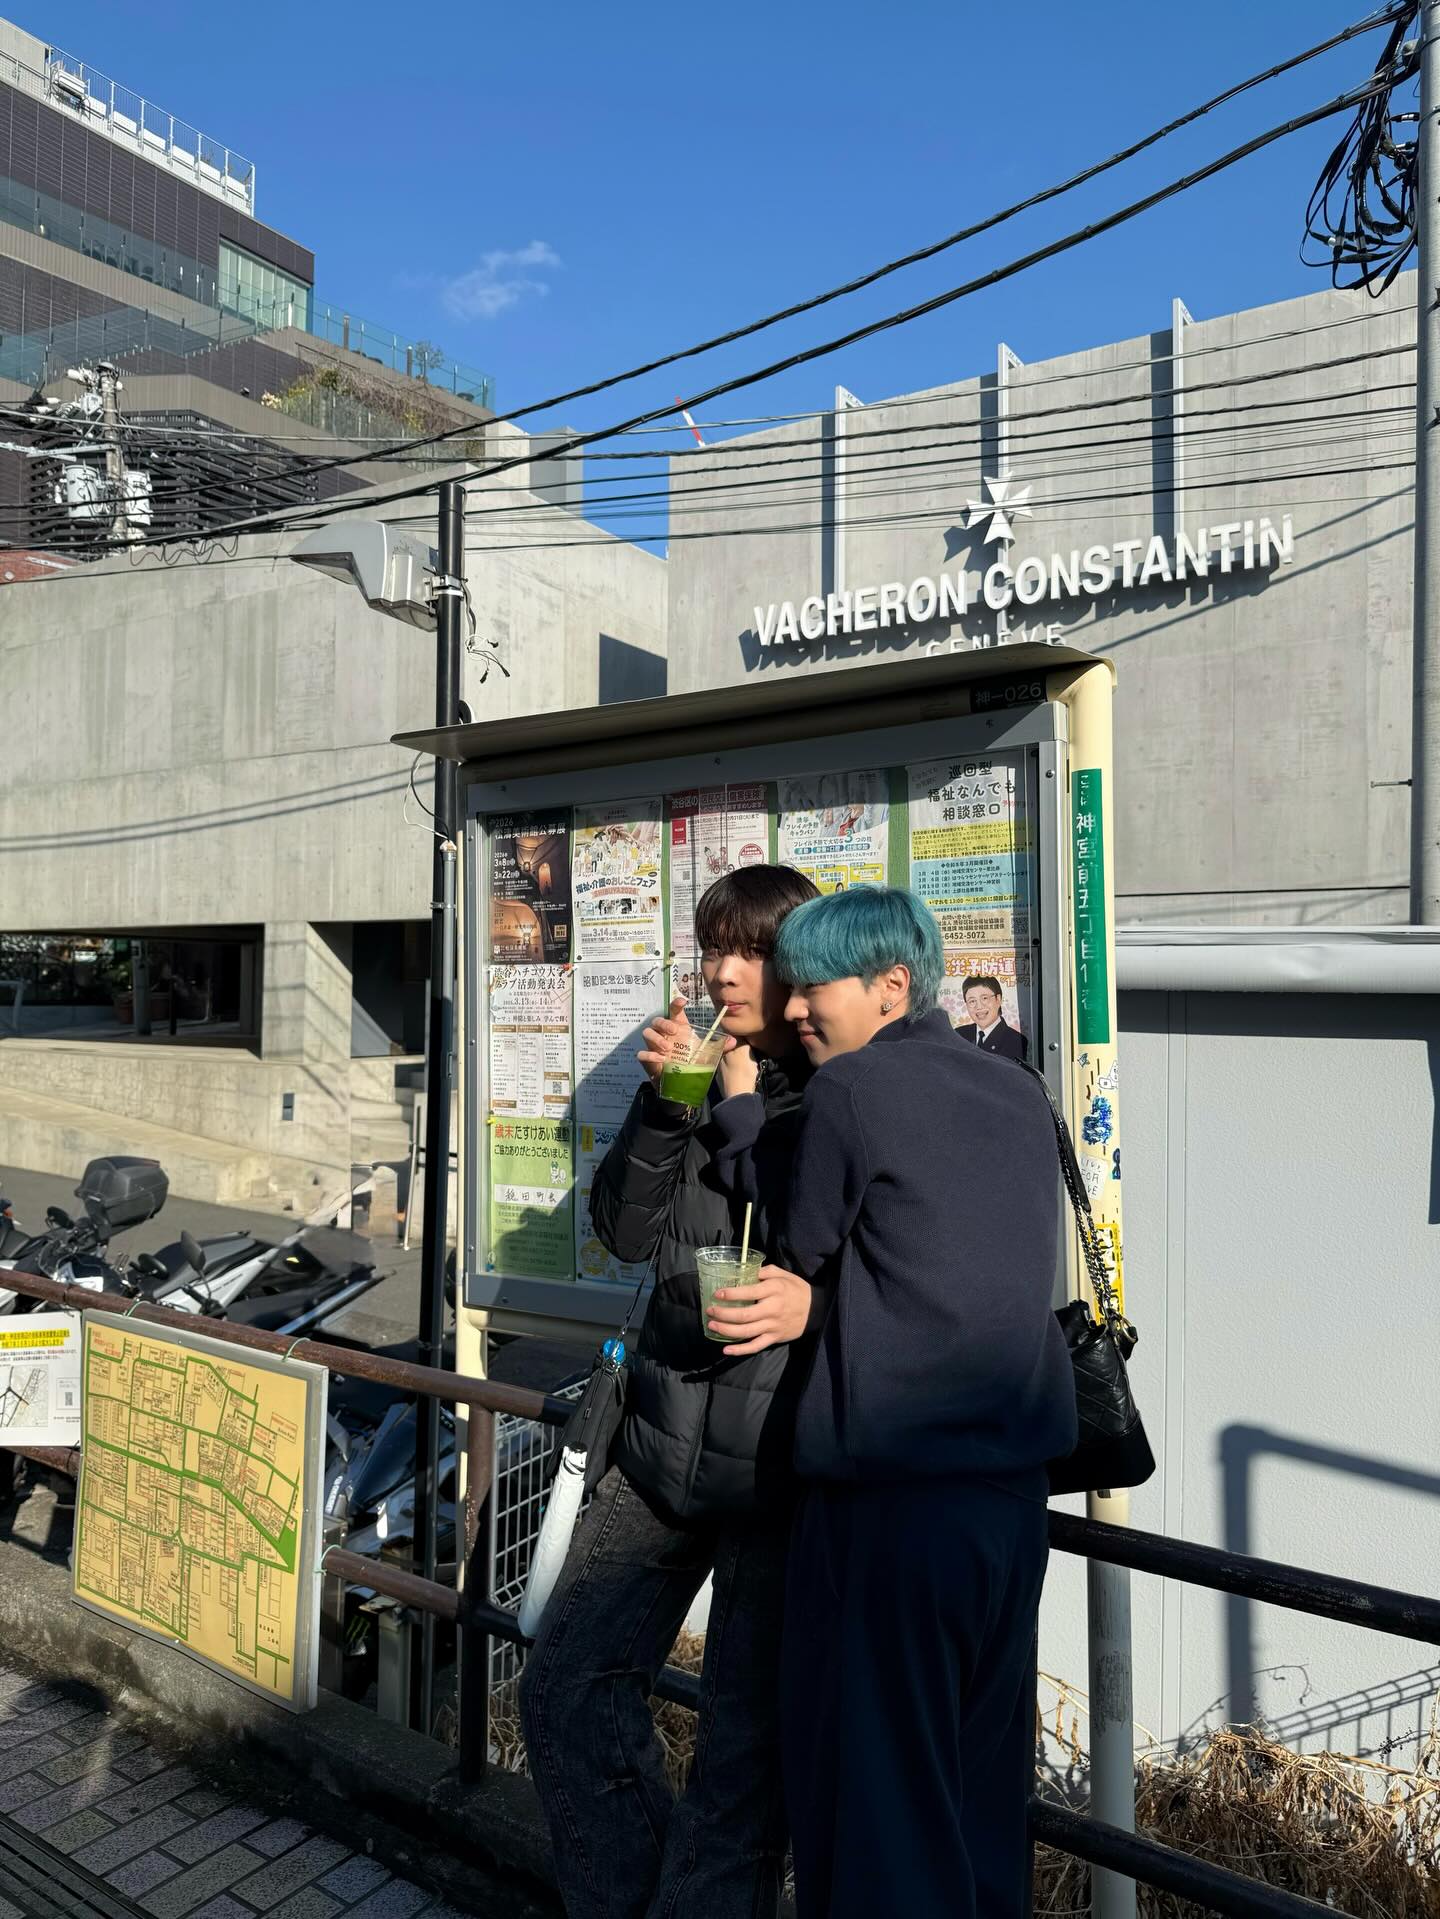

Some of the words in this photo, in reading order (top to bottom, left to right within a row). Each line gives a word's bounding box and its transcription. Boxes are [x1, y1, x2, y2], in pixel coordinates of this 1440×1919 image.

[753, 569, 968, 646] VACHERON
[983, 513, 1294, 610] CONSTANTIN
[949, 761, 992, 779] 巡回型
[928, 781, 1016, 803] 福祉なんでも
[943, 803, 1000, 821] 相談窓口
[575, 876, 657, 894] 福祉・介護のおしごとフェア
[583, 974, 656, 988] 昭和記念公園を歩く
[673, 1042, 691, 1051] 100%
[495, 1122, 570, 1142] 歳末たすけあい運動
[495, 1144, 569, 1159] ご協力ありがとうございました
